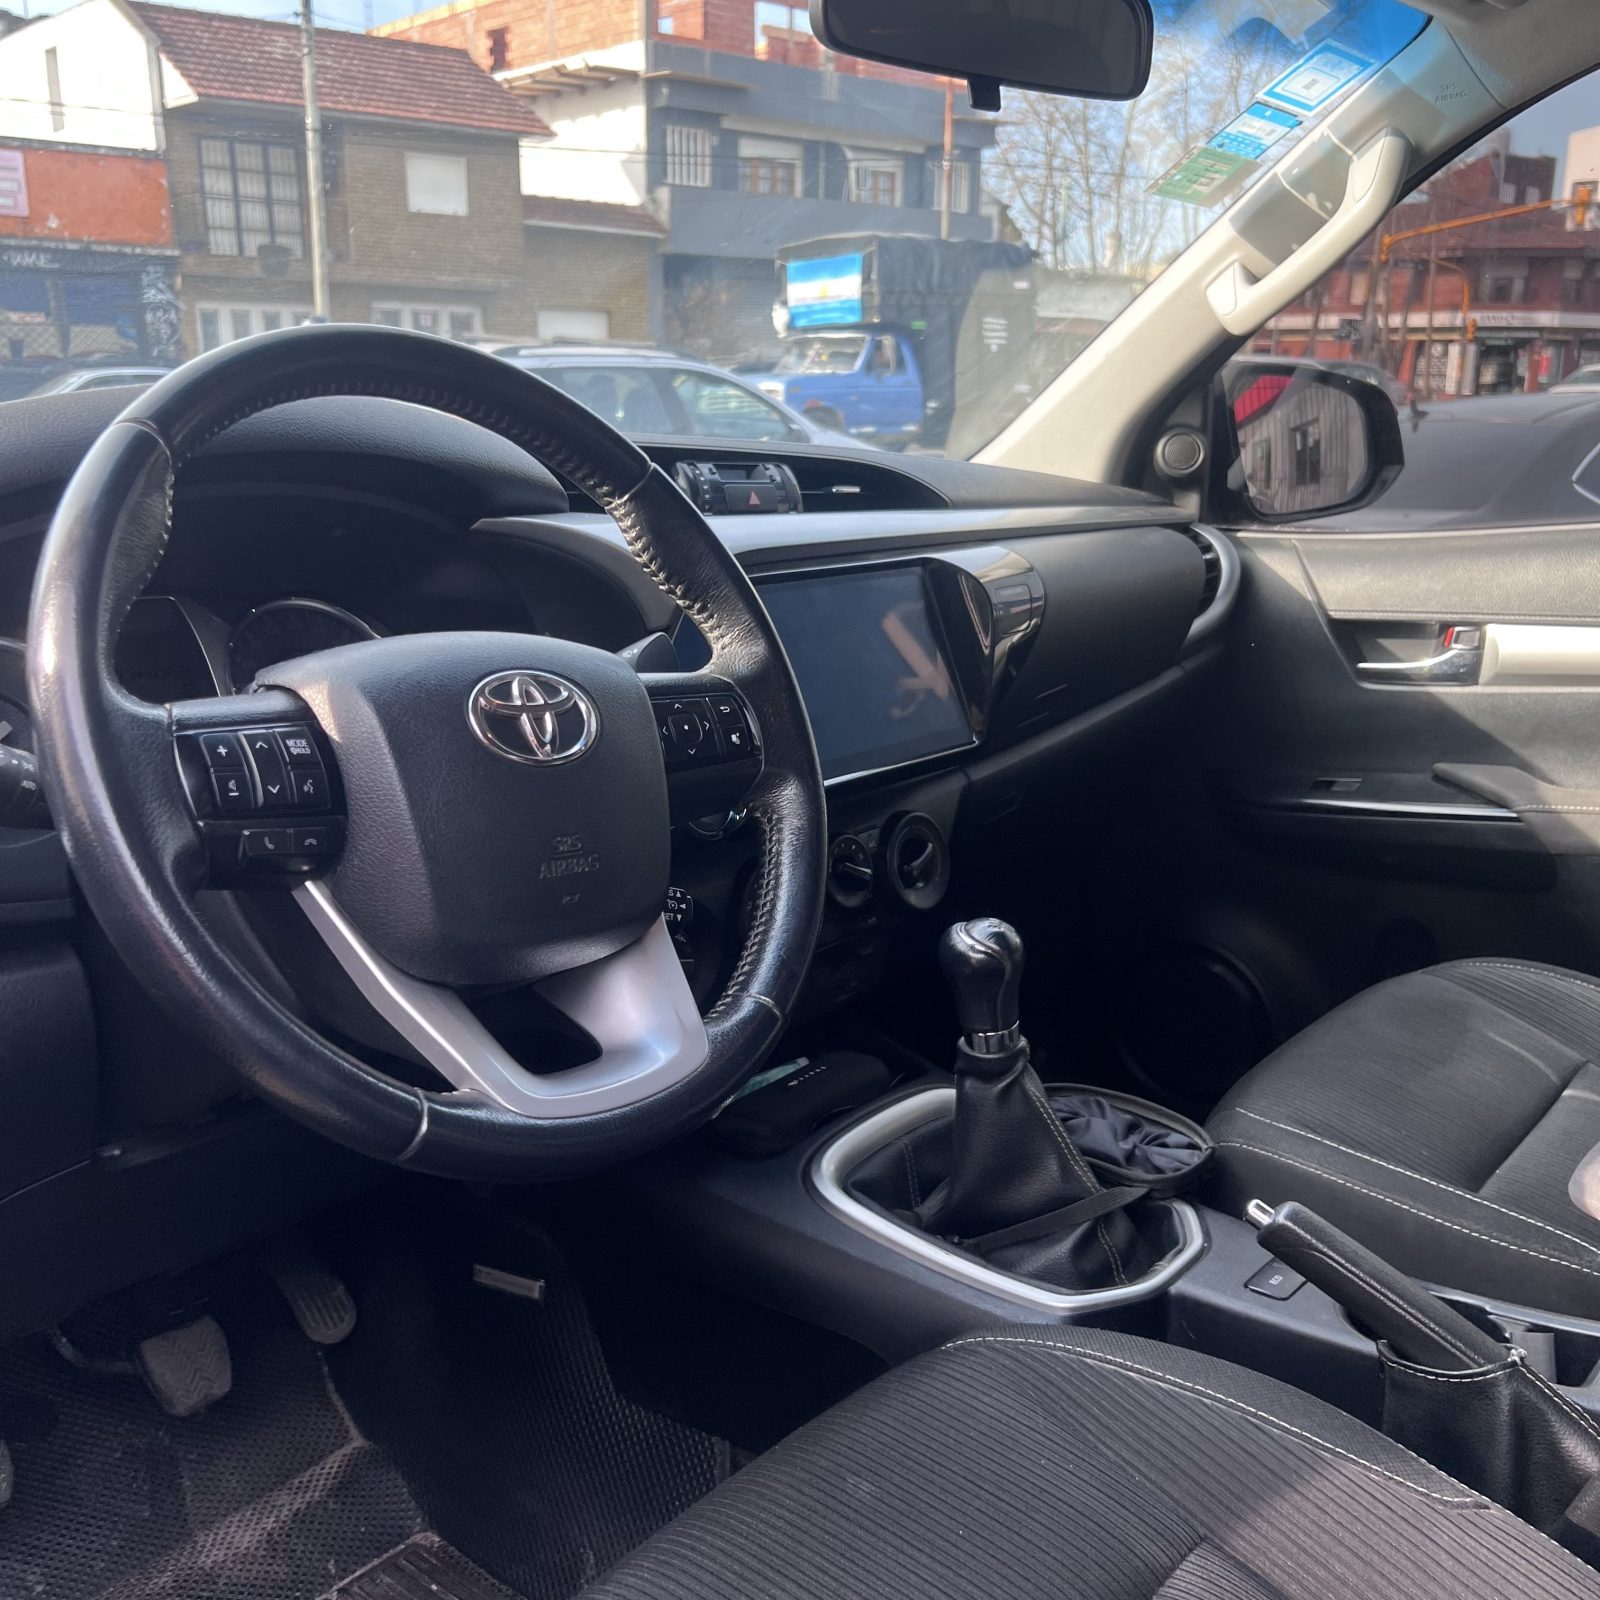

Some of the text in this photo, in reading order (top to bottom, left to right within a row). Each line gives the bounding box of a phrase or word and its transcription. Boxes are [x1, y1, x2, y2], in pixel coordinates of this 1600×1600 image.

[286, 739, 309, 747] MODE
[552, 834, 582, 852] SRS
[539, 854, 600, 879] AIRBAG
